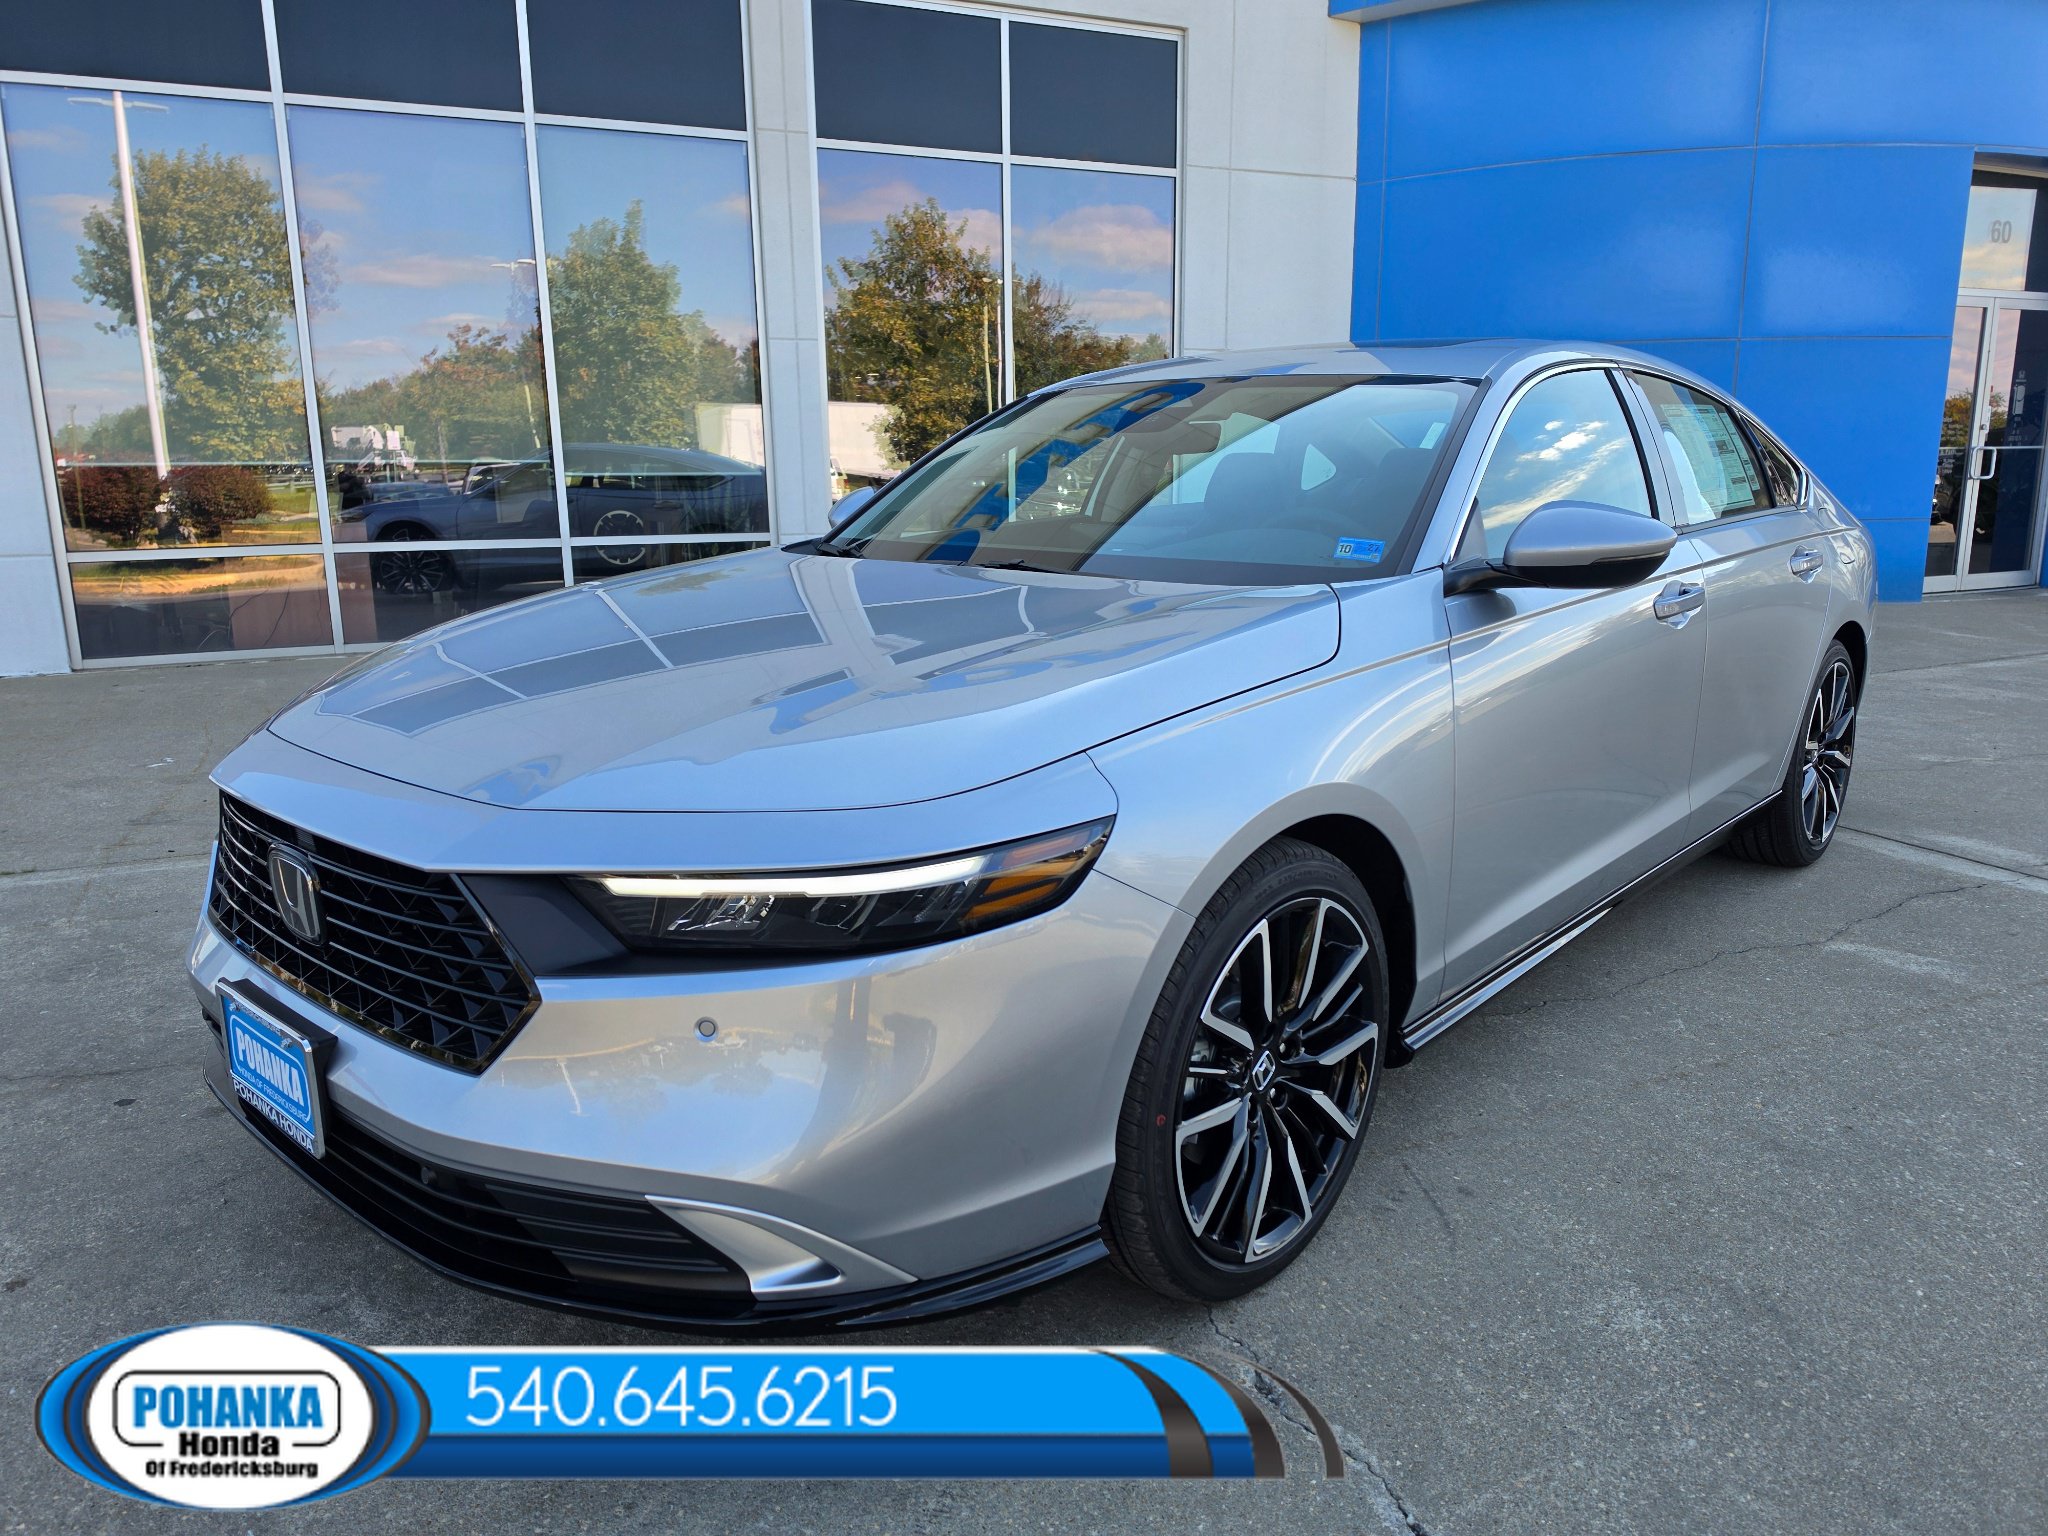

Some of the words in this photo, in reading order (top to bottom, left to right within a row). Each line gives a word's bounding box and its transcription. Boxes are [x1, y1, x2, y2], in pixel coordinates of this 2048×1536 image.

[1991, 219, 2012, 243] 60
[1339, 544, 1352, 554] 10
[235, 1027, 305, 1106] POHANKA
[233, 1079, 279, 1125] POHANKA
[280, 1116, 314, 1153] HONDA
[239, 1068, 256, 1084] HONDA
[264, 1083, 307, 1122] FREDERICKSBURG
